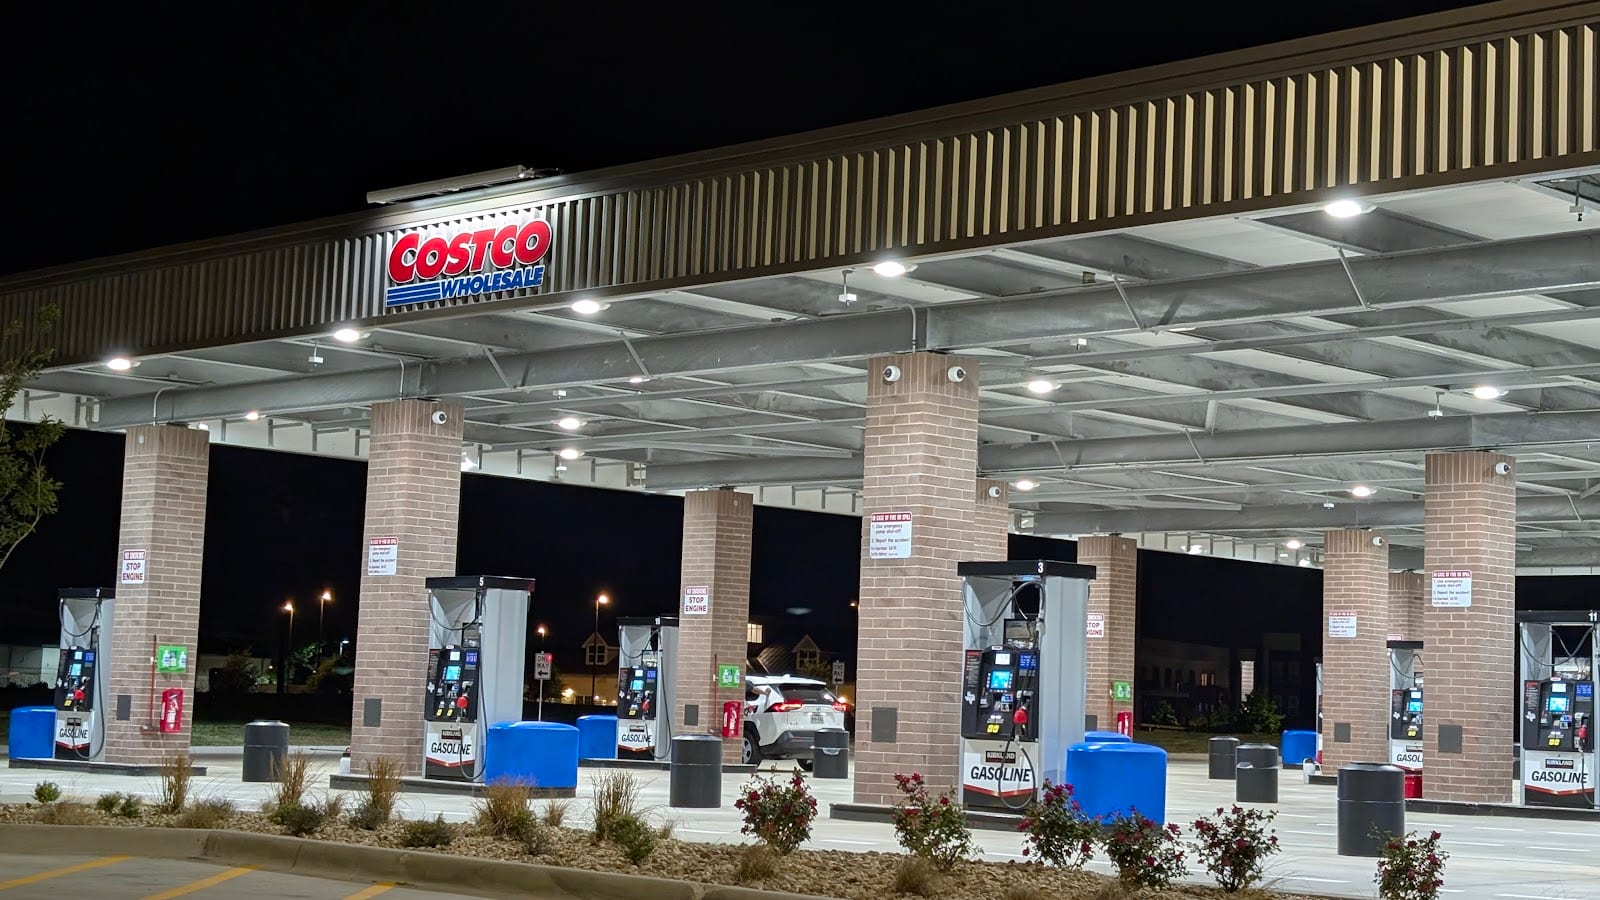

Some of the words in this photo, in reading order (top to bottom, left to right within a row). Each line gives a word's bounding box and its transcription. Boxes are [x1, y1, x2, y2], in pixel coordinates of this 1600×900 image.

[388, 218, 552, 283] COSTCO
[440, 265, 545, 298] WHOLESALE
[126, 562, 141, 571] STOP
[1038, 562, 1044, 574] 3
[123, 572, 144, 581] ENGINE
[480, 576, 484, 587] 5
[1588, 610, 1598, 622] 11
[59, 728, 88, 739] GASOLINE
[431, 742, 472, 755] GASOLINE
[971, 766, 1032, 782] GASOLINE
[1532, 771, 1588, 783] GASOLINE
